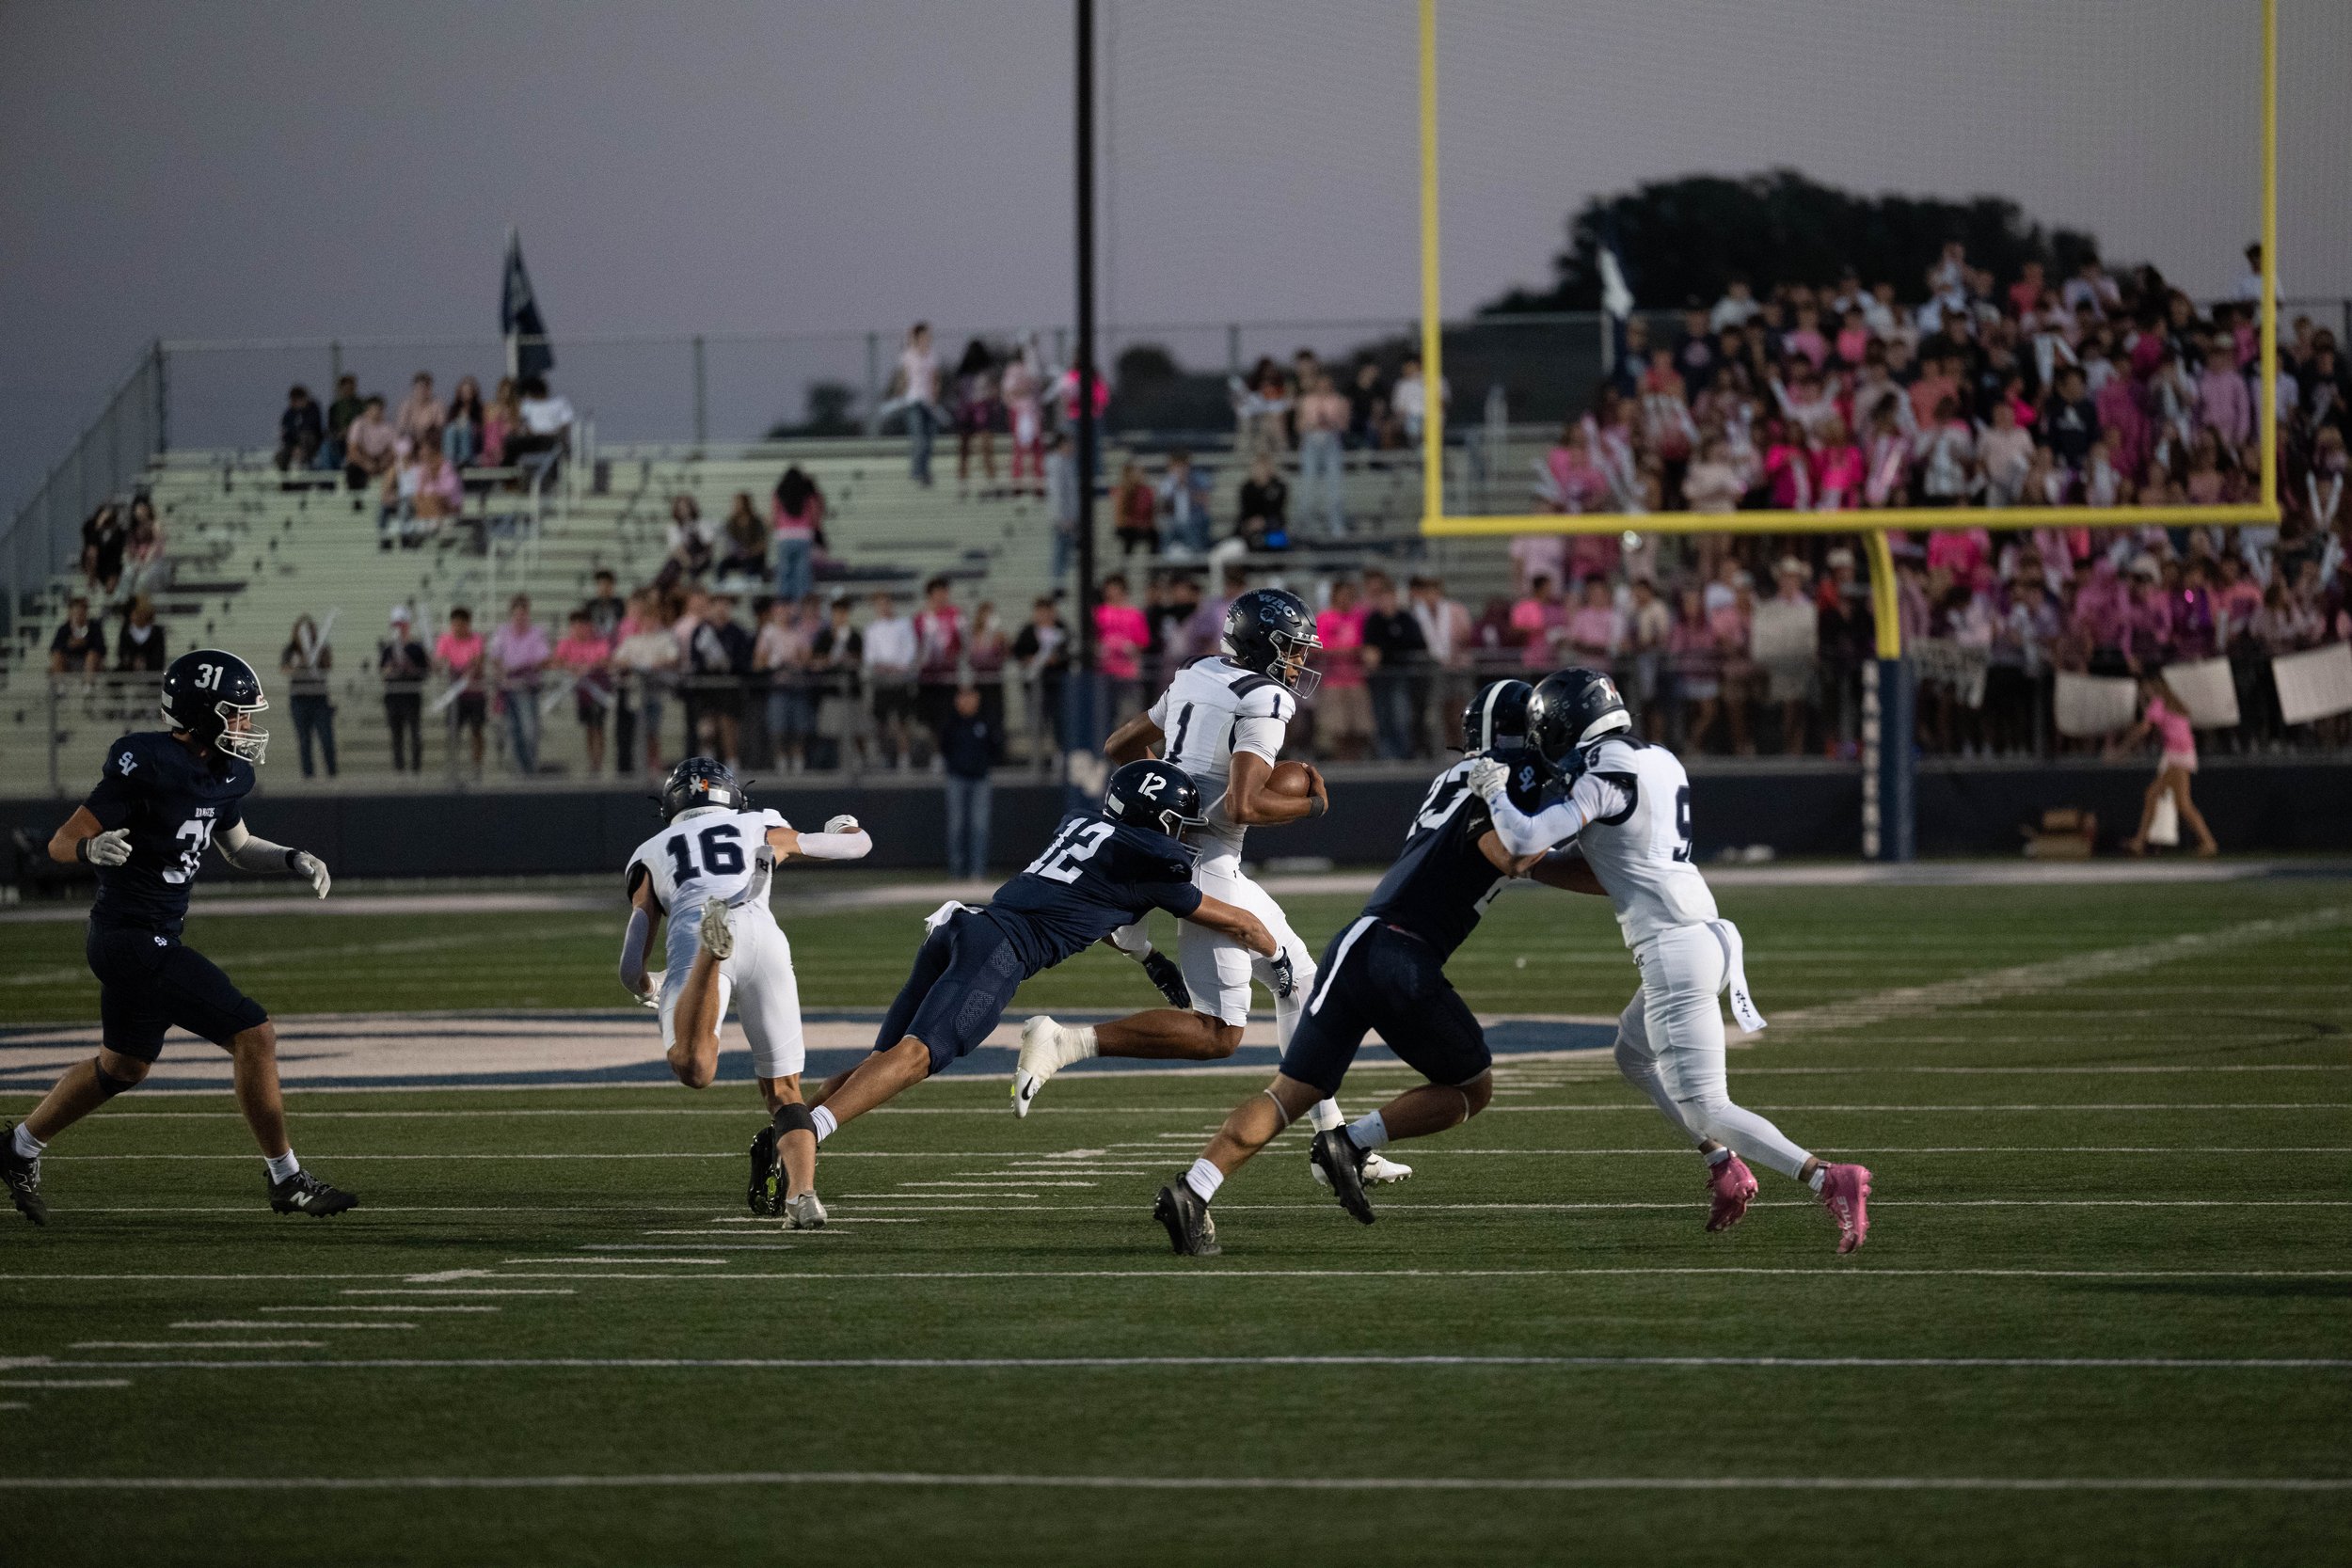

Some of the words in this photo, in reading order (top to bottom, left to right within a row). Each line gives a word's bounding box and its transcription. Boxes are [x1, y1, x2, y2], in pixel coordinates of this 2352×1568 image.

[194, 663, 225, 691] 31
[1271, 692, 1282, 719] 1
[1166, 701, 1195, 764] 1
[119, 752, 138, 776] SV
[1138, 772, 1167, 800] 12
[666, 823, 746, 889] 16
[1023, 816, 1116, 884] 12
